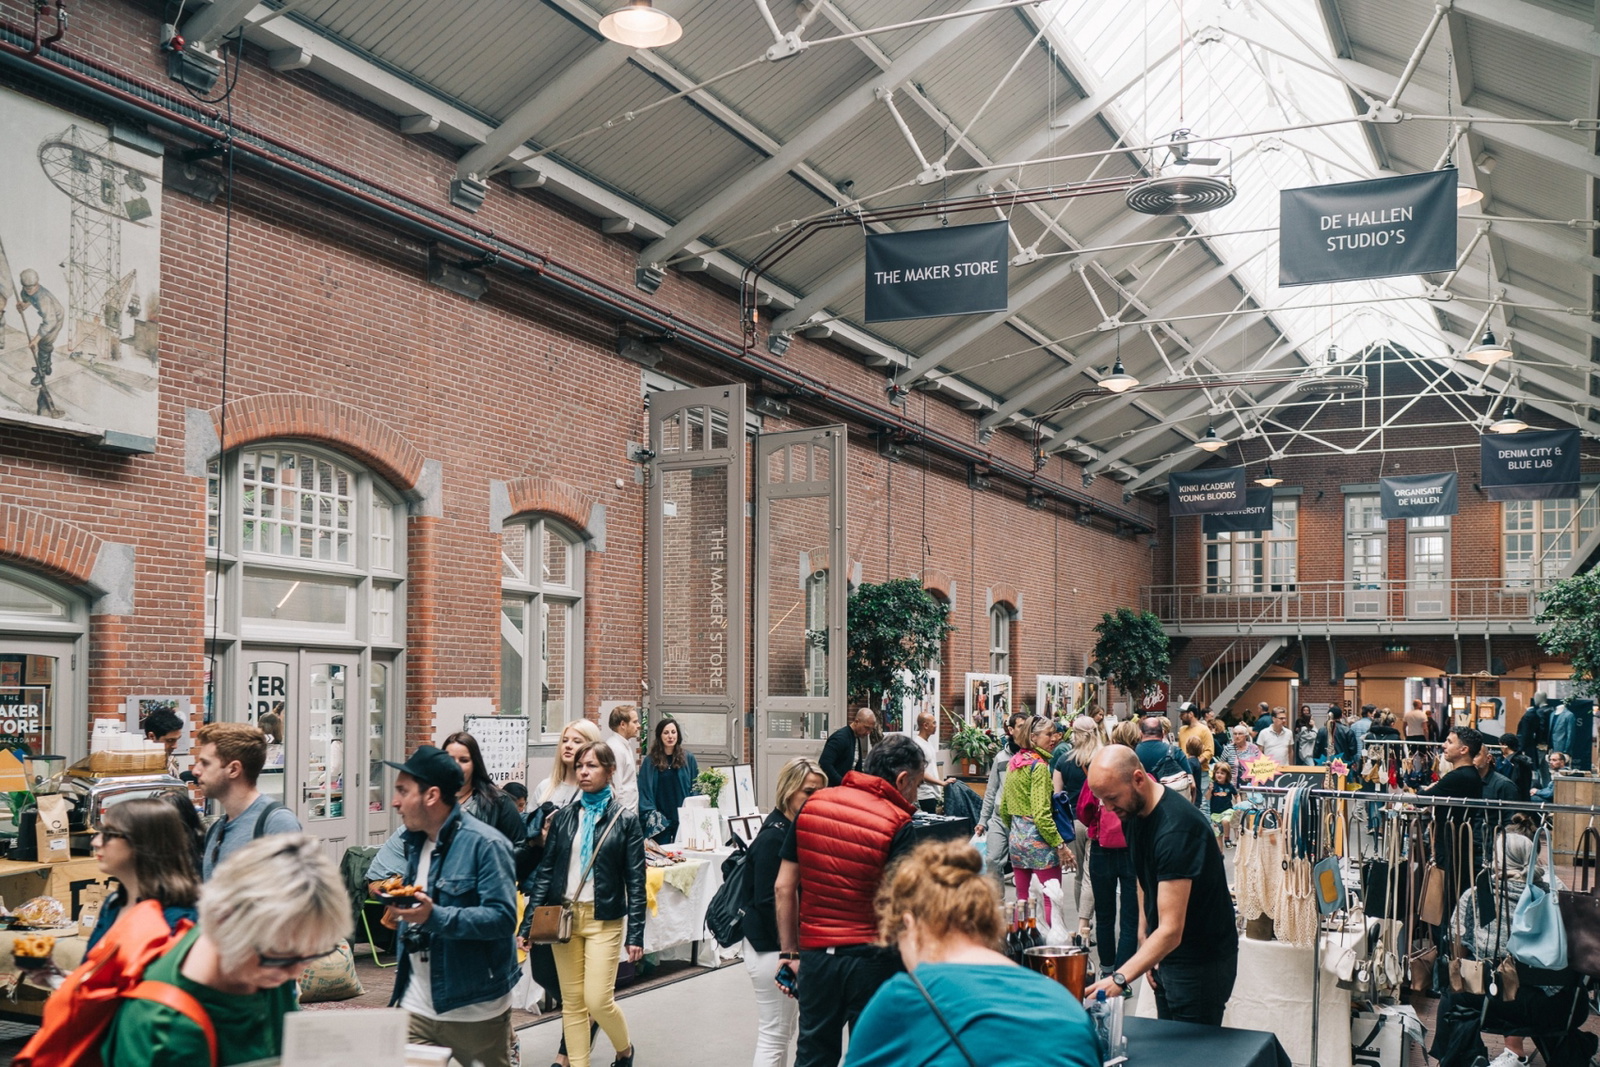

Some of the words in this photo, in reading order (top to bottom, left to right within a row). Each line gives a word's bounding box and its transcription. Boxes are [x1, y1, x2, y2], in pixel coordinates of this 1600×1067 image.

[1320, 214, 1342, 230] DE
[1347, 206, 1413, 227] HALLEN
[1326, 229, 1406, 252] STUDIO'S
[874, 270, 901, 285] THE
[904, 265, 950, 282] MAKER
[954, 260, 999, 277] STORE
[1498, 449, 1528, 459] DENIM
[1530, 447, 1552, 457] CITY
[1554, 446, 1563, 456] &
[1508, 460, 1532, 470] BLUE
[1534, 459, 1553, 469] LAB
[1179, 485, 1199, 493] KINKI
[1200, 481, 1236, 491] ACADEMY
[1394, 486, 1444, 497] ORGANISATIE
[1178, 493, 1206, 502] YOUNG
[1206, 491, 1237, 500] BLOODS
[1398, 498, 1409, 506] DE
[1410, 496, 1440, 505] HALLEN
[711, 526, 724, 561] THE
[710, 567, 723, 626] MAKER
[709, 632, 723, 688] STORE
